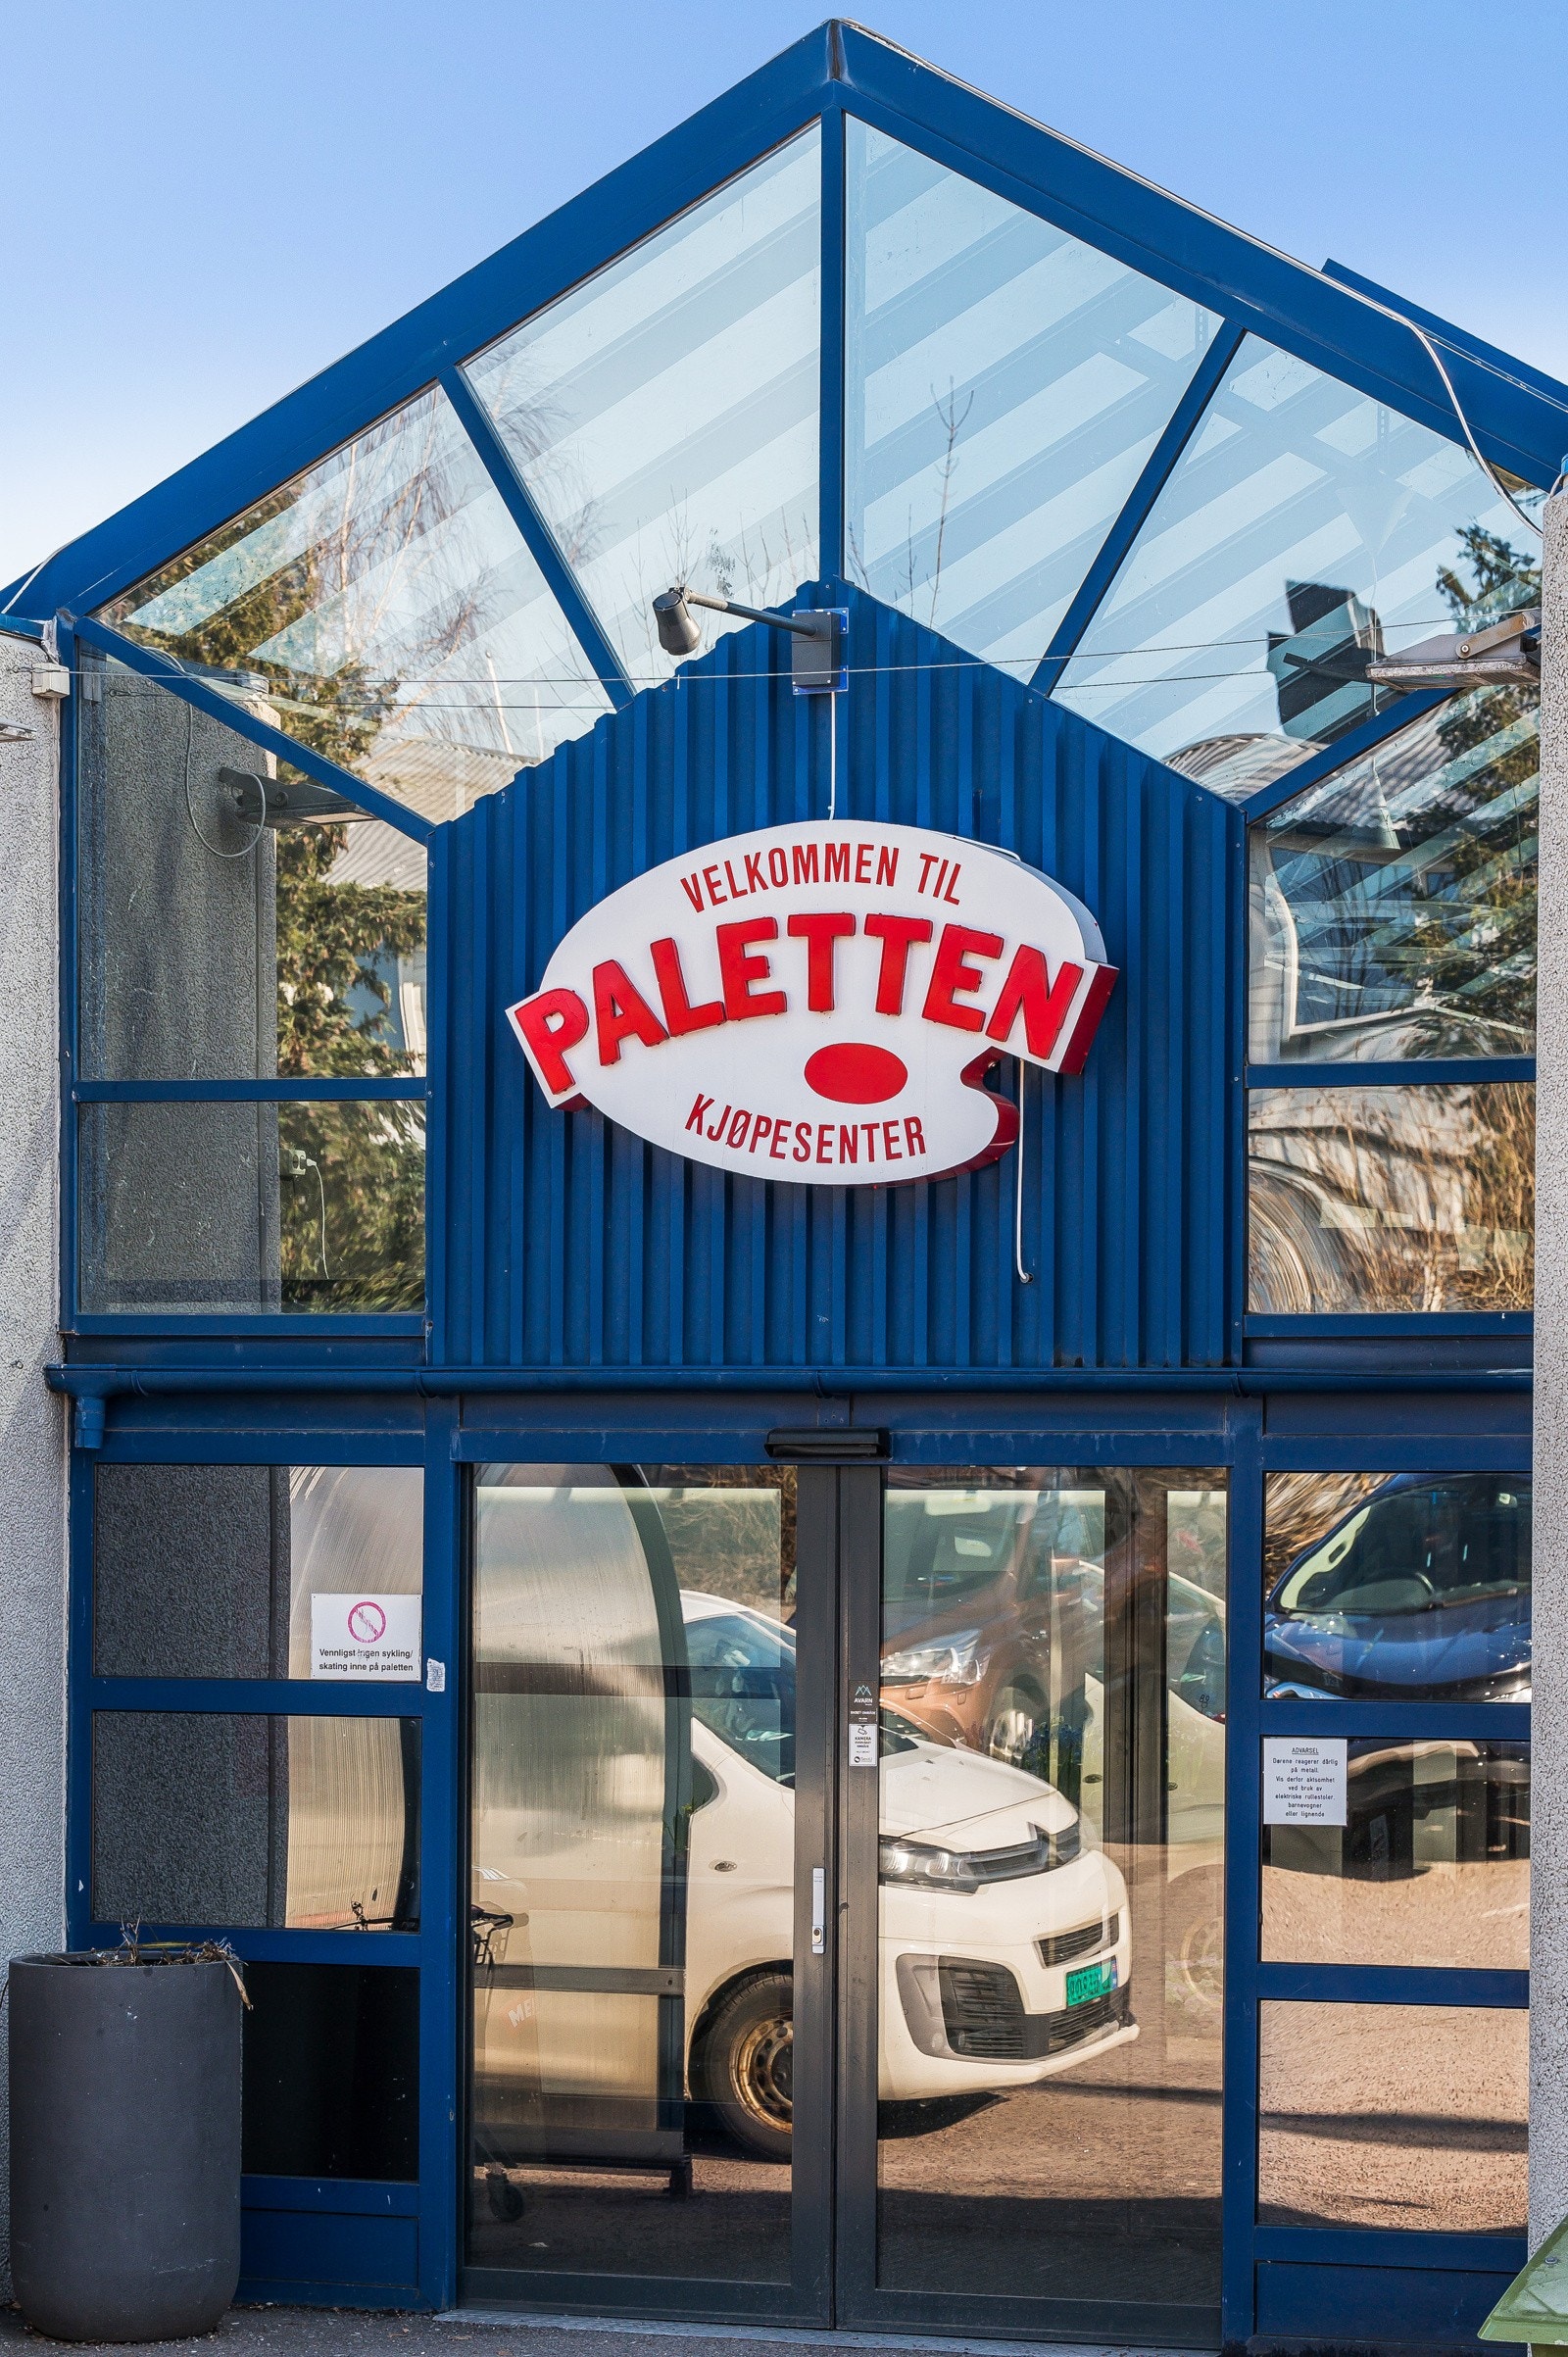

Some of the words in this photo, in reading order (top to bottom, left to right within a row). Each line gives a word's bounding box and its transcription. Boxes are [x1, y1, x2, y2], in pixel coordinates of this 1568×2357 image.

[680, 843, 900, 913] VELKOMMEN
[918, 853, 962, 906] TIL
[514, 912, 1084, 1095] PALETTEN
[684, 1093, 926, 1164] KJØPESENTER
[318, 1648, 356, 1658] Vennligst
[318, 1662, 348, 1672] skating
[368, 1662, 379, 1672] på
[380, 1663, 414, 1672] paletten
